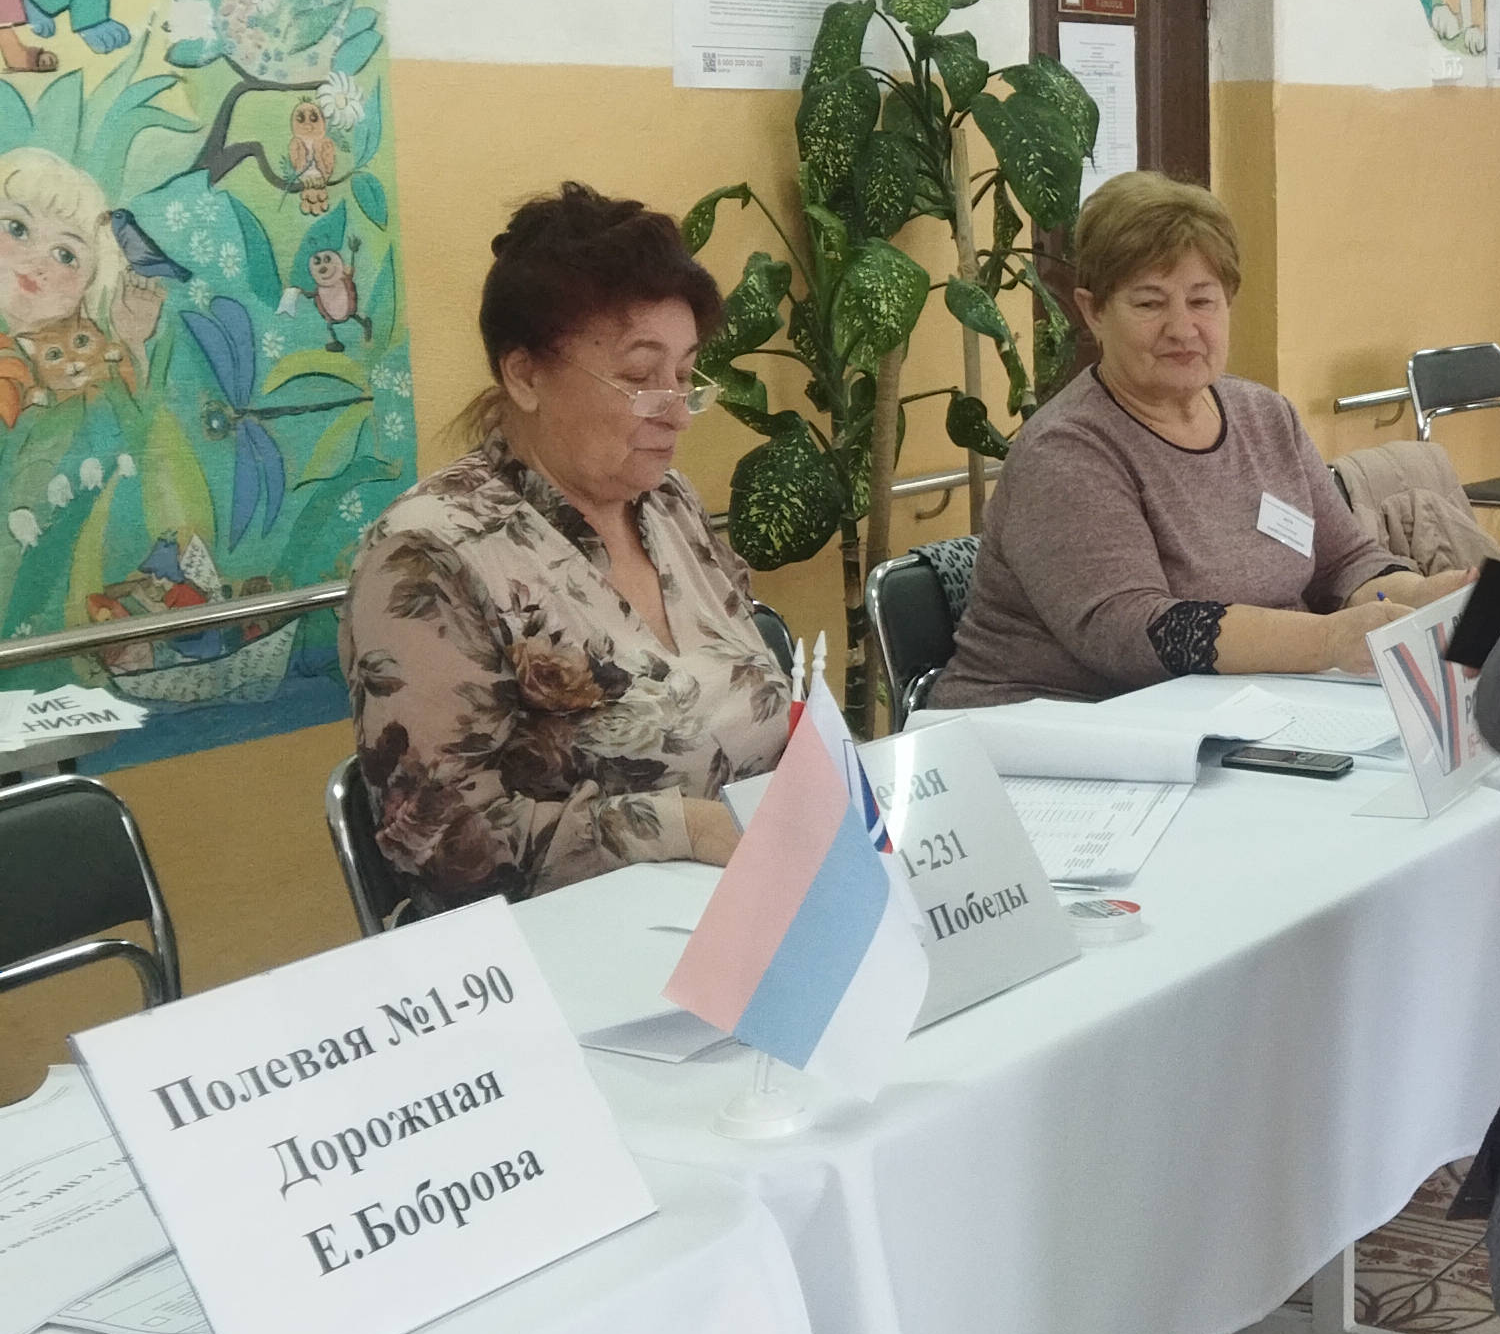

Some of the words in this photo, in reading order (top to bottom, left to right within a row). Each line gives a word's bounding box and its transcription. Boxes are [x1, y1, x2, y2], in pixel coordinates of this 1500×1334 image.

[925, 883, 1030, 942] Победы
[151, 1025, 376, 1132] Полевая
[379, 964, 516, 1046] №1-90
[269, 1069, 506, 1200] Дорожная
[302, 1143, 546, 1278] Е.Боброва
